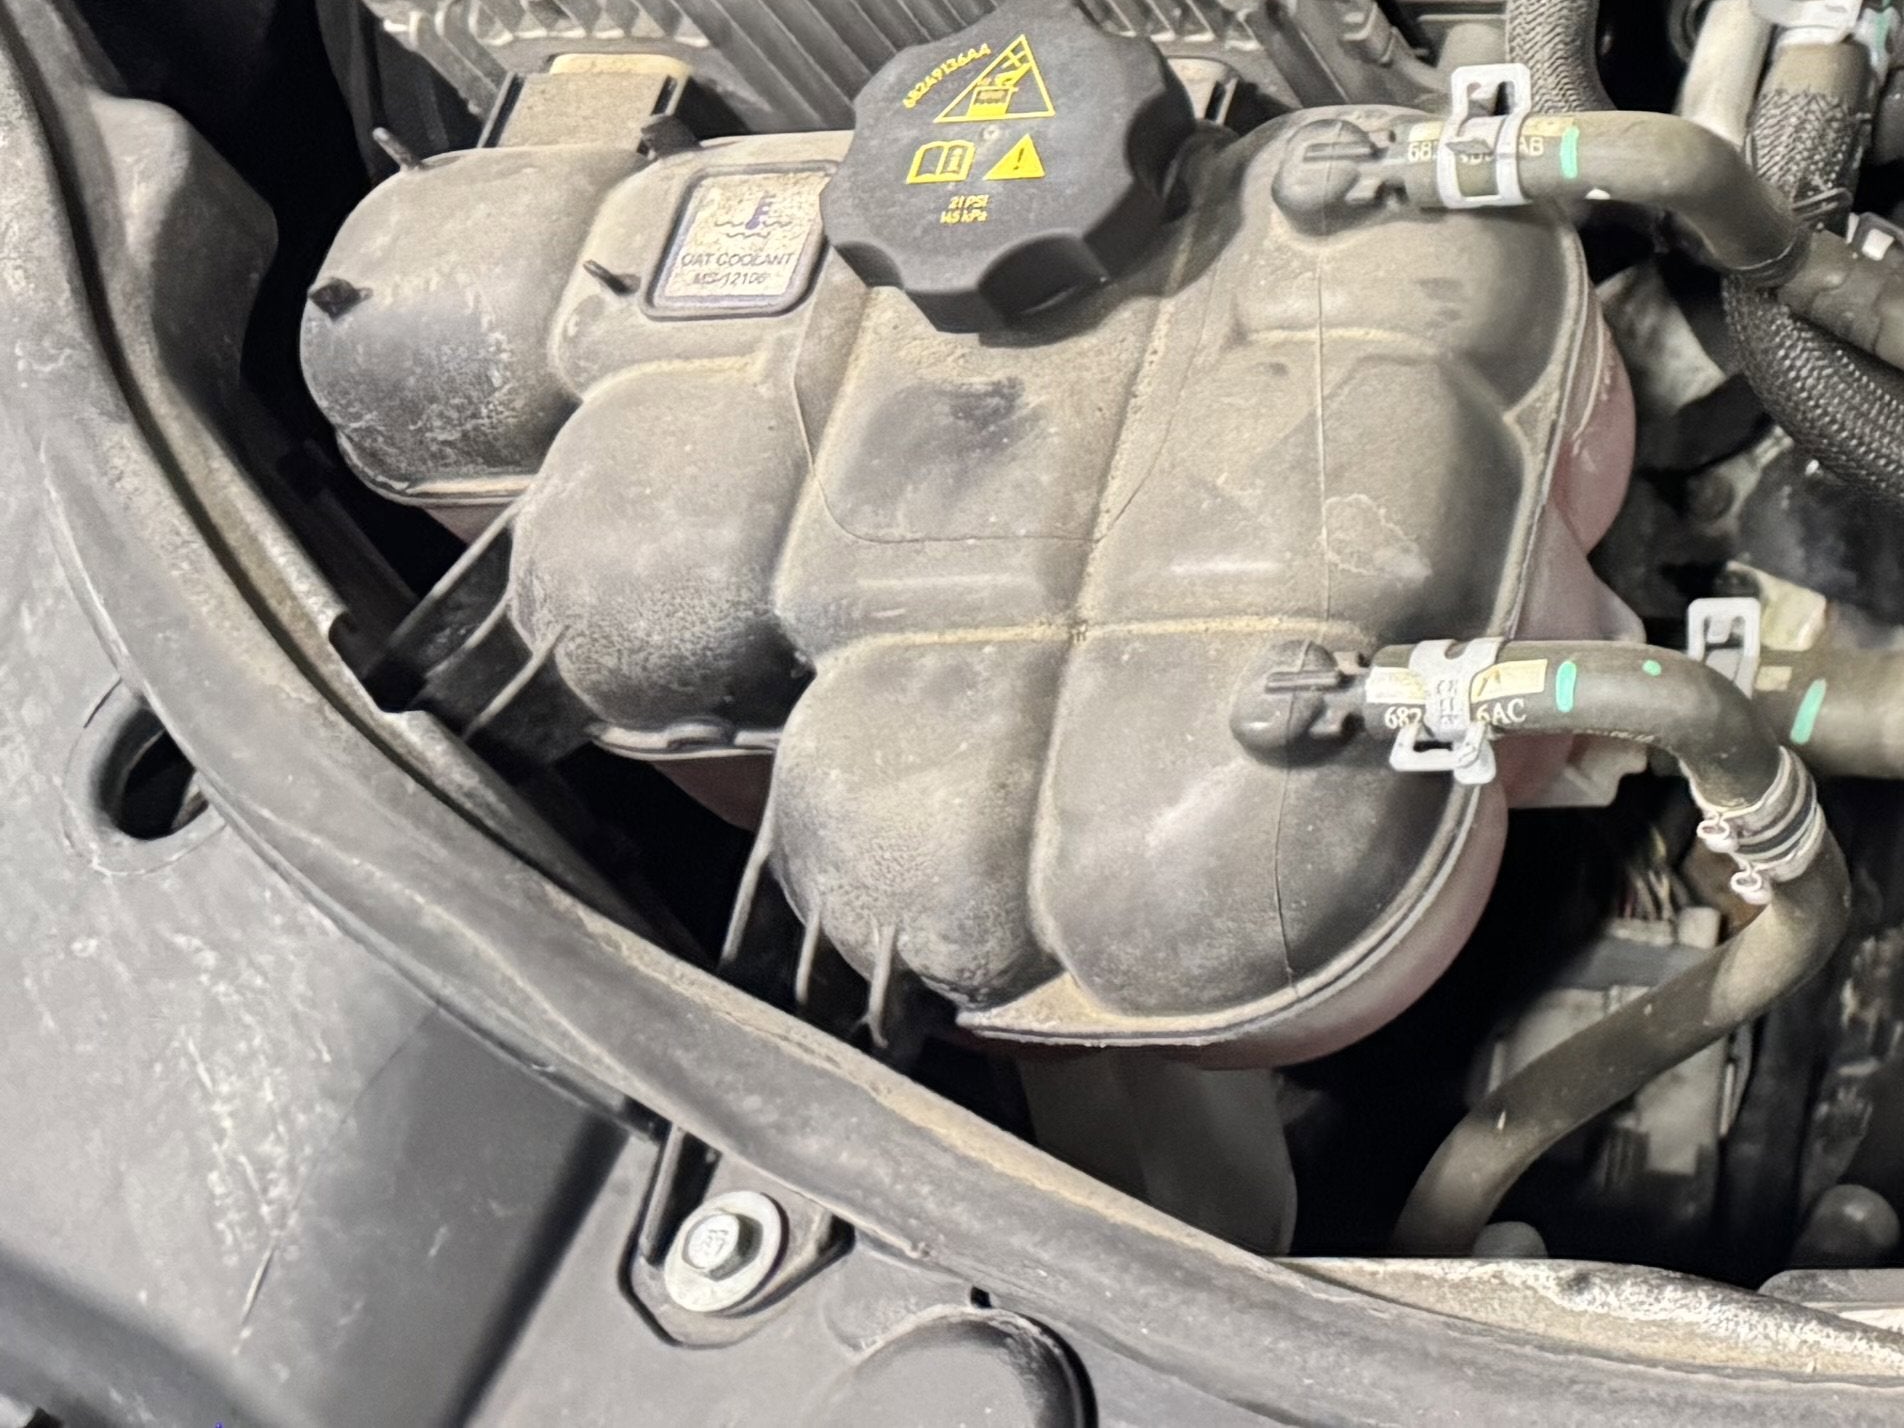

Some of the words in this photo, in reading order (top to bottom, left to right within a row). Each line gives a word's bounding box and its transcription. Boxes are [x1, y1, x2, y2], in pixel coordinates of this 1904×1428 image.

[965, 194, 990, 208] PSI
[681, 252, 716, 268] OAT
[716, 251, 796, 267] COOLANT
